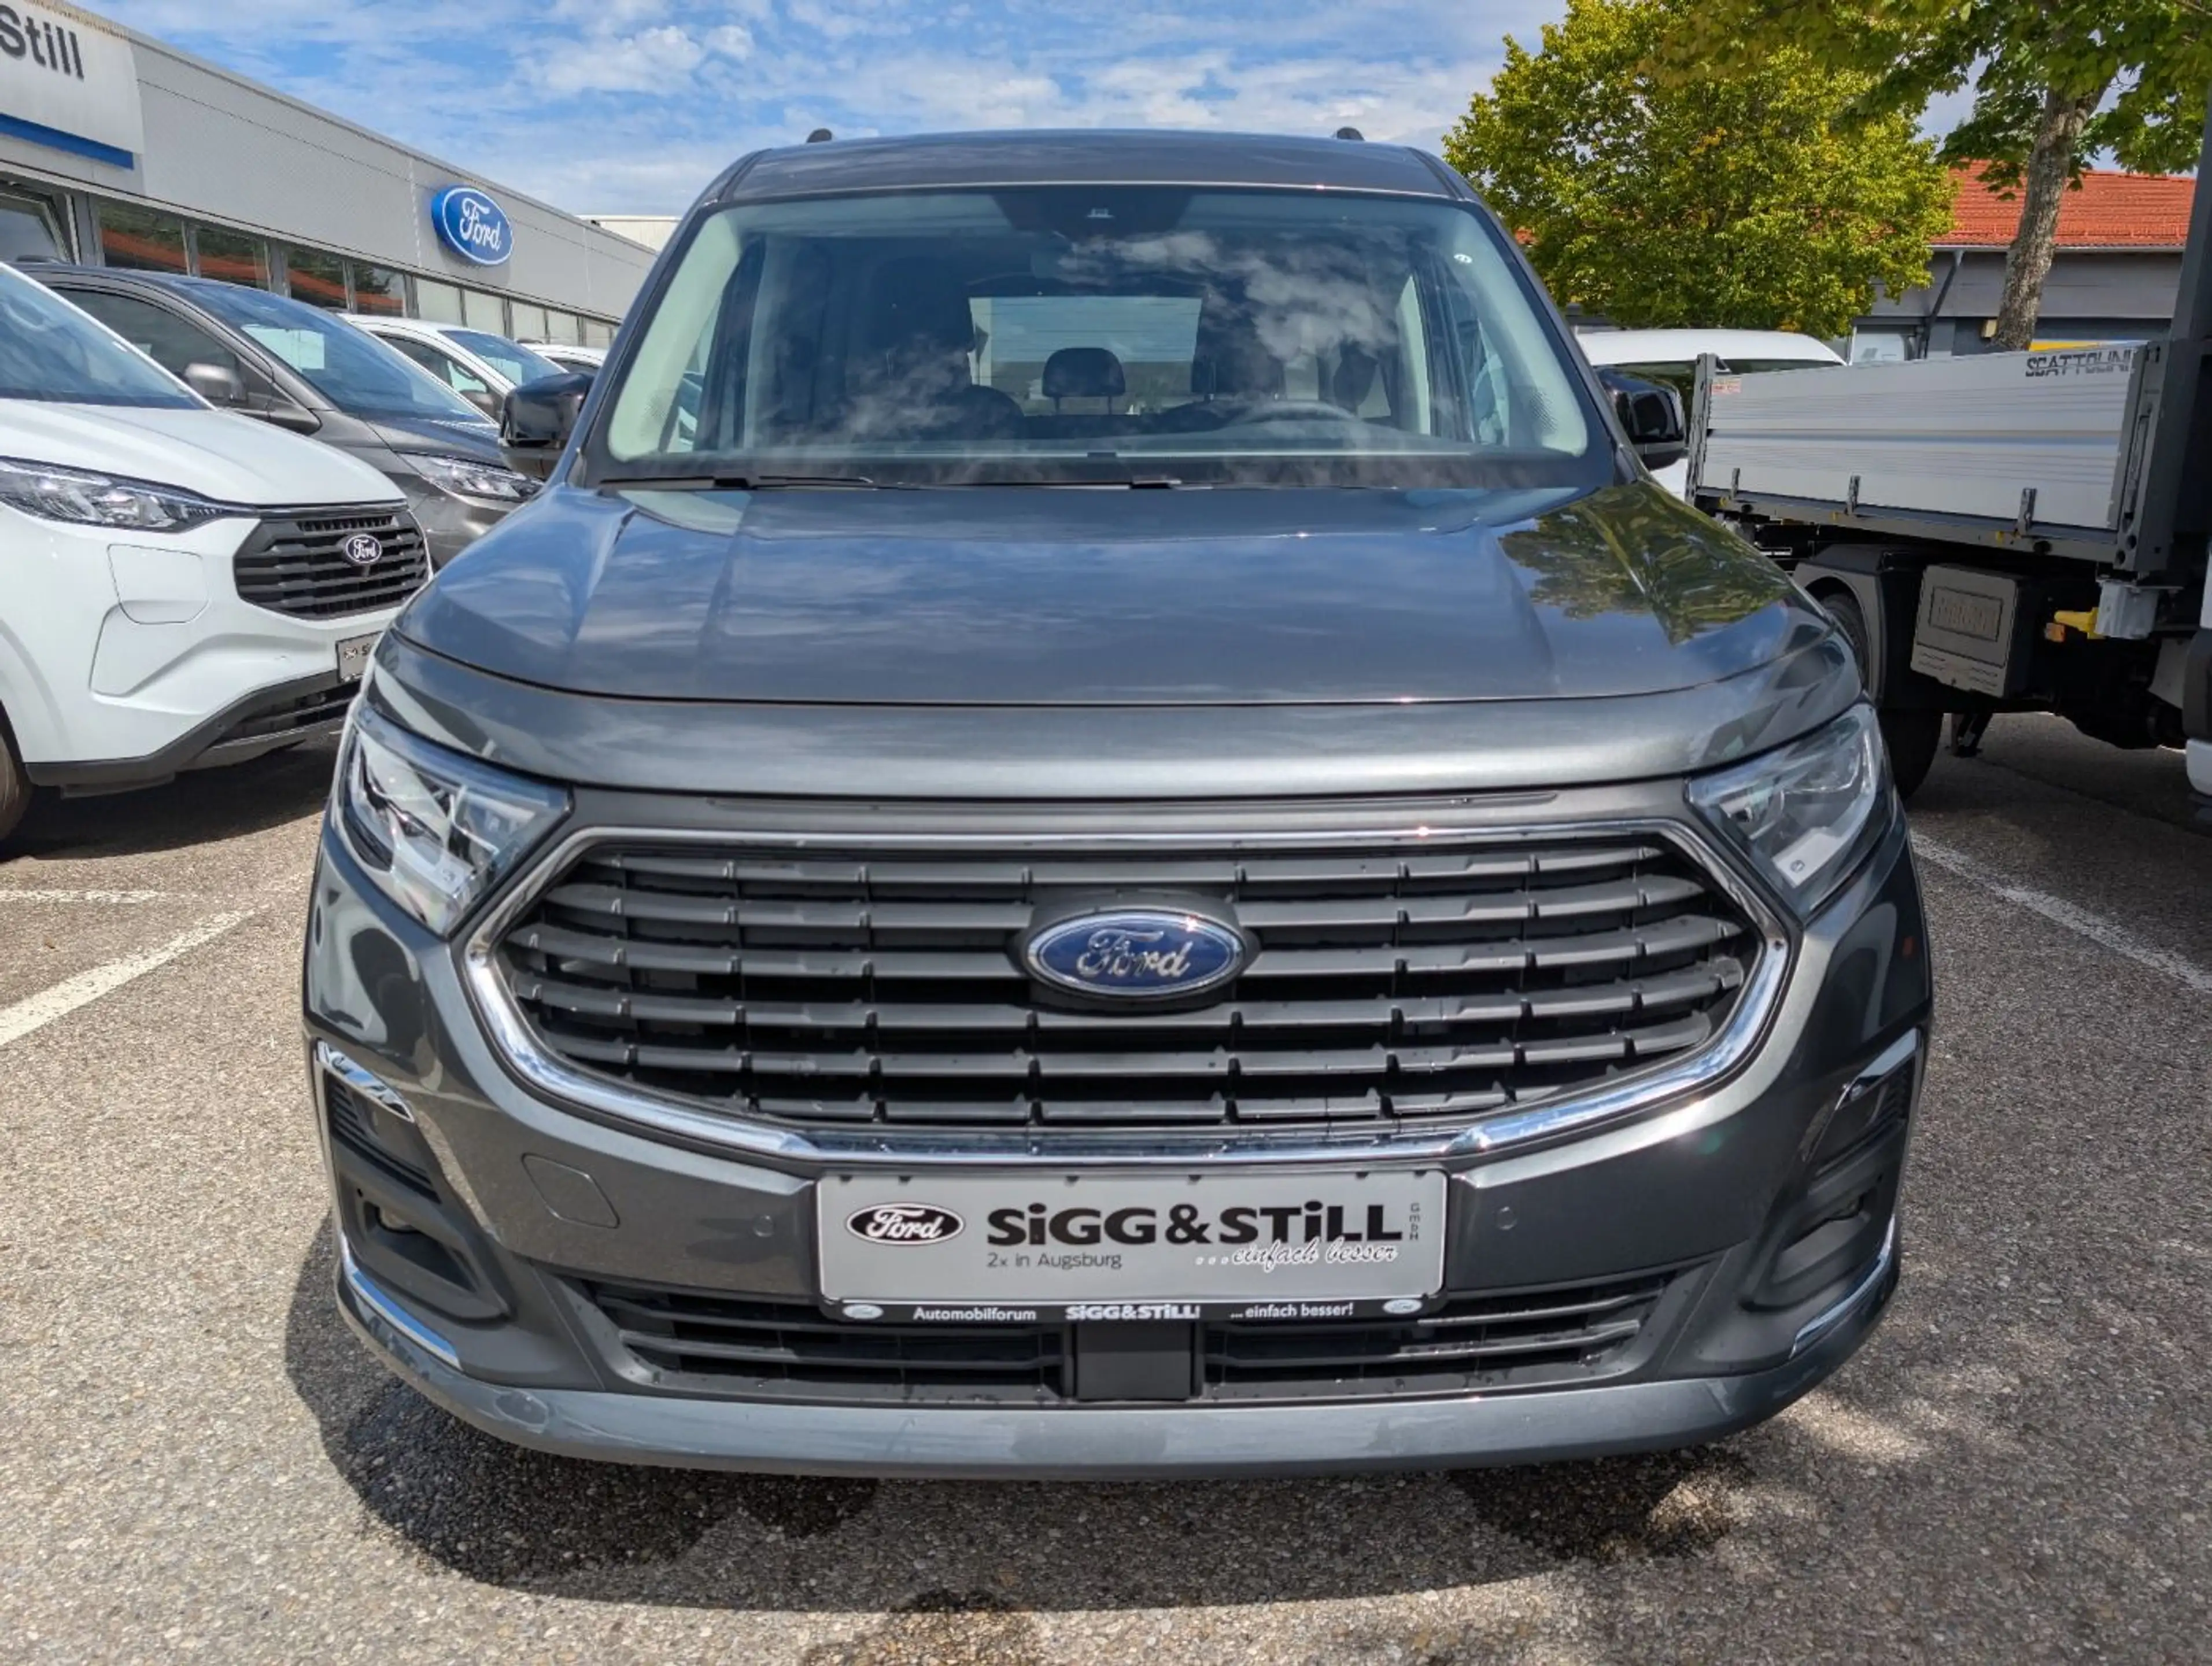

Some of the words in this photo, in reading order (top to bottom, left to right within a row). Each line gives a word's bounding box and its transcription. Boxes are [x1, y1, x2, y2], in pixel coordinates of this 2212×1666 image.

[0, 4, 84, 82] Still
[460, 197, 501, 251] Ford
[354, 539, 376, 558] Ford
[1076, 928, 1194, 977] Ford
[866, 1207, 944, 1239] Ford
[987, 1252, 1007, 1267] 2x
[1015, 1253, 1031, 1267] in
[1037, 1252, 1122, 1270] Augsburg
[1325, 1236, 1398, 1263] besser
[913, 1306, 1036, 1321] Automobilforum
[1301, 1302, 1354, 1317] besser!
